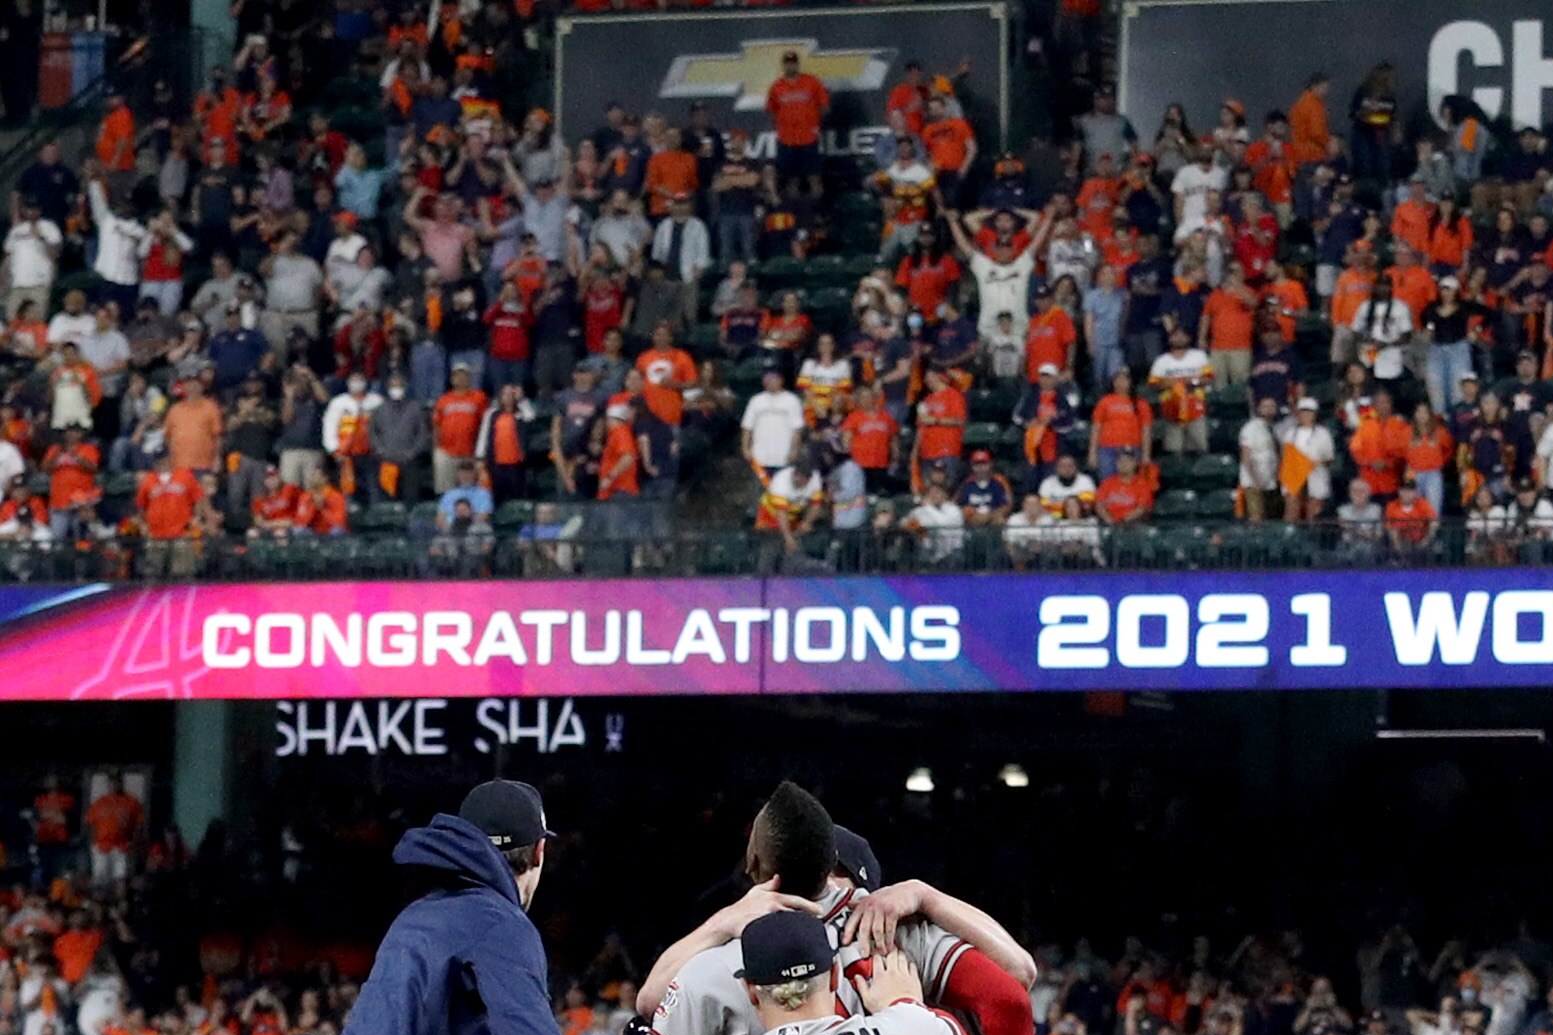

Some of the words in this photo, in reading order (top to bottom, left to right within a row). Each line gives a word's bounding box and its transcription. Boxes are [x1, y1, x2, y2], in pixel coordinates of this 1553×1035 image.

[202, 604, 961, 669] CONGRATULATIONS
[1037, 594, 1347, 668] 2021
[275, 698, 448, 756] SHAKE
